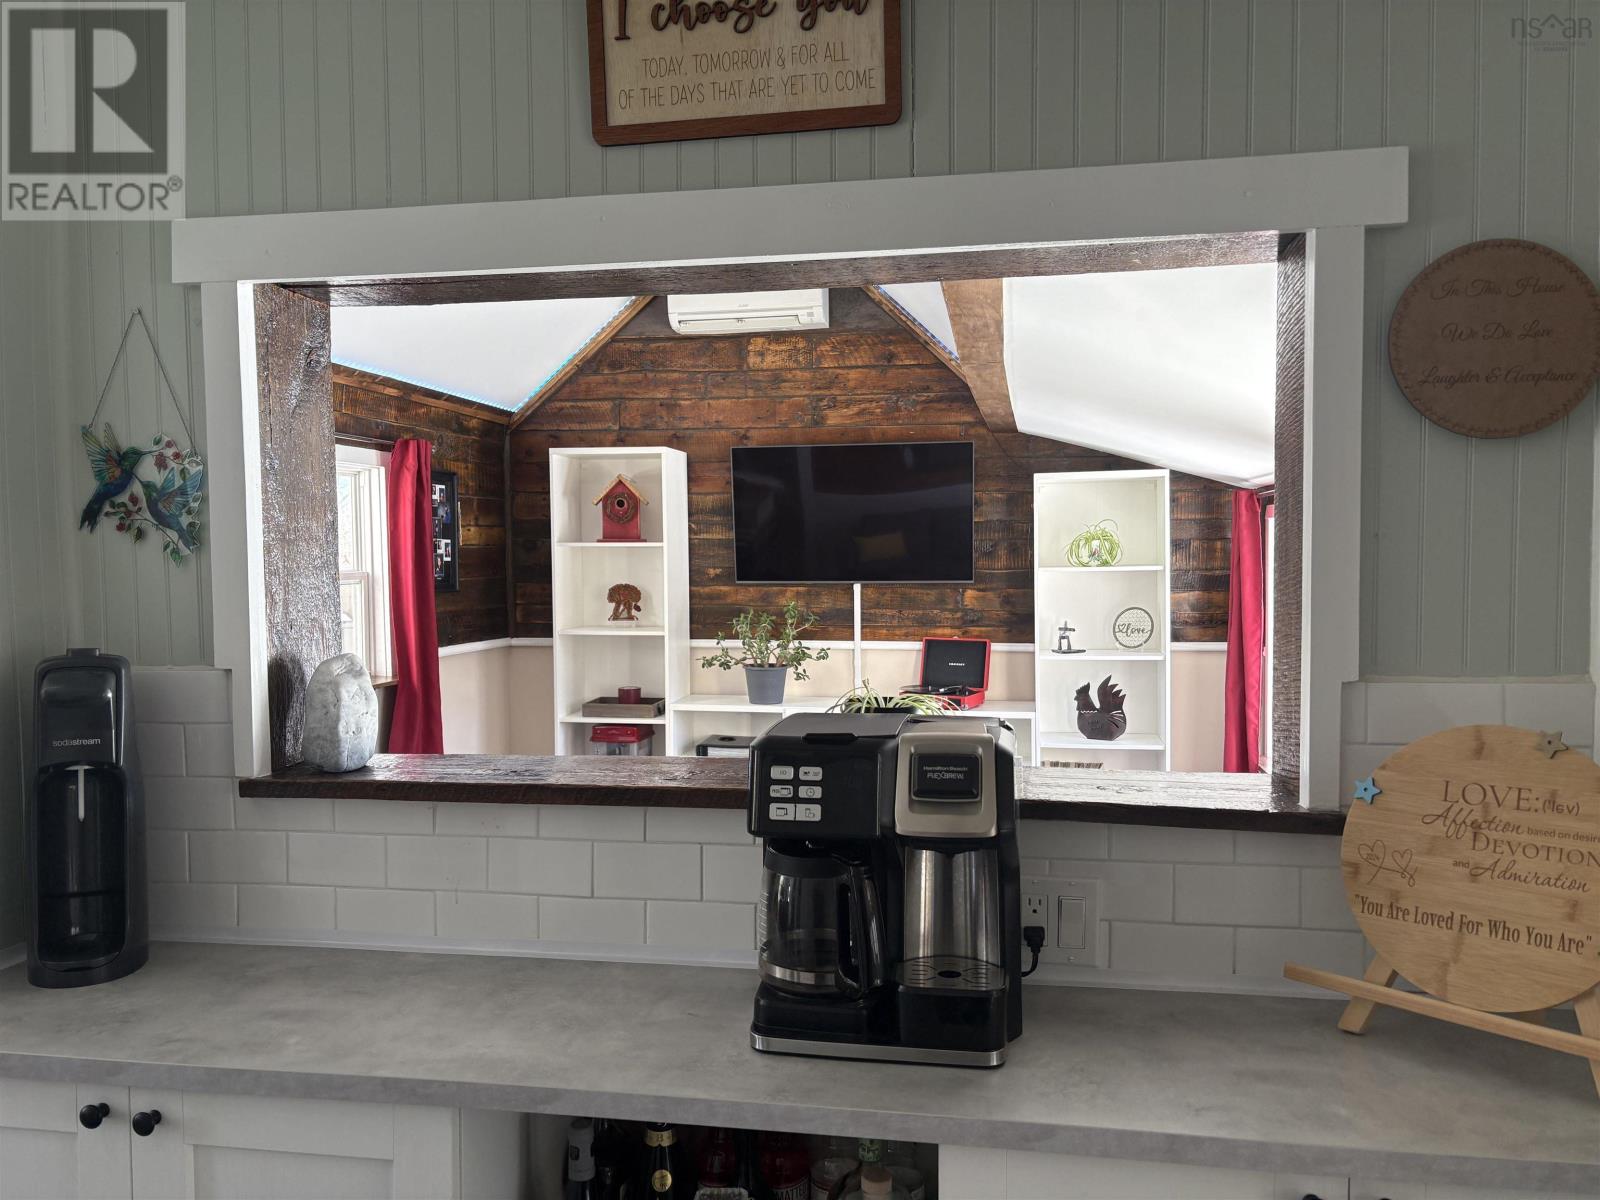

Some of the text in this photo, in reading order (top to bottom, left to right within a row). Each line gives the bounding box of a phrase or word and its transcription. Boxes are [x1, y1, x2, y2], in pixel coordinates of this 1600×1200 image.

[692, 51, 771, 74] TOMORROW
[776, 47, 786, 69] &
[791, 45, 818, 66] FOR
[824, 41, 850, 63] ALL
[618, 68, 877, 110] OF THE DAYS THAT ARE YET TO COME
[1431, 276, 1566, 300] In This House
[1441, 319, 1554, 342] We Do Love
[1418, 365, 1577, 389] Laughter & Acceptance
[52, 738, 101, 747] sodastream
[1441, 779, 1540, 813] LOVE:
[1421, 801, 1524, 840] Affection
[1527, 826, 1555, 839] based
[1557, 831, 1571, 840] on
[1471, 831, 1600, 868] DEVOTION
[1452, 858, 1591, 893] and Admiration
[1354, 893, 1592, 955] "You Are Loved For Who You Are"
